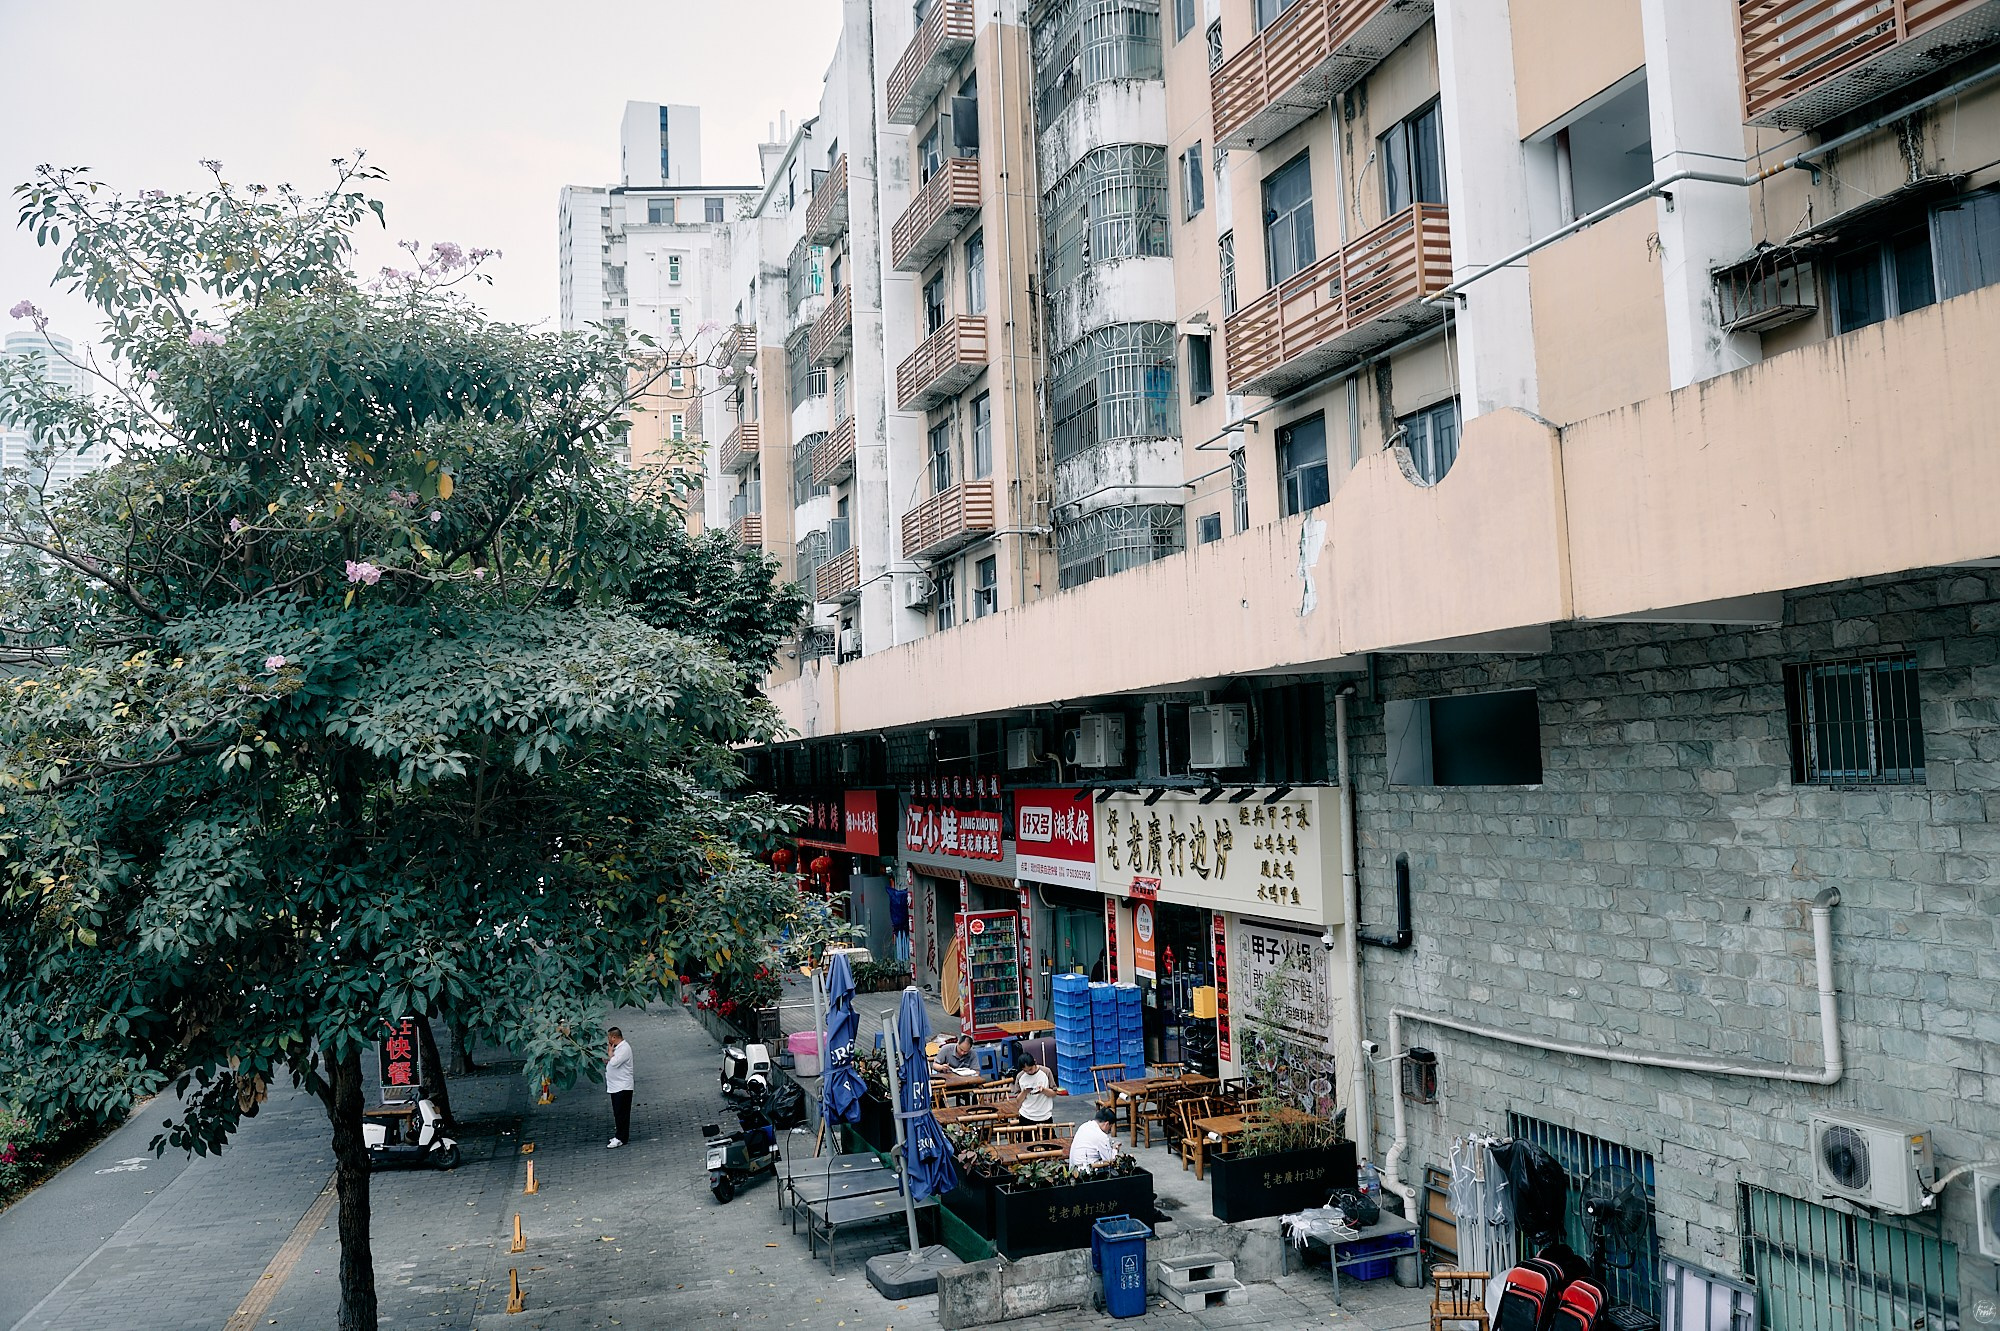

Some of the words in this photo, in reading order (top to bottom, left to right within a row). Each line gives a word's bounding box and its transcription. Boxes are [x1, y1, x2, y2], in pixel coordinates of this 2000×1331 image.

[907, 807, 959, 850] 江小蛙
[1022, 812, 1050, 835] 好又多
[1054, 806, 1089, 846] 湘菜馆
[1252, 934, 1312, 974] 甲子火锅
